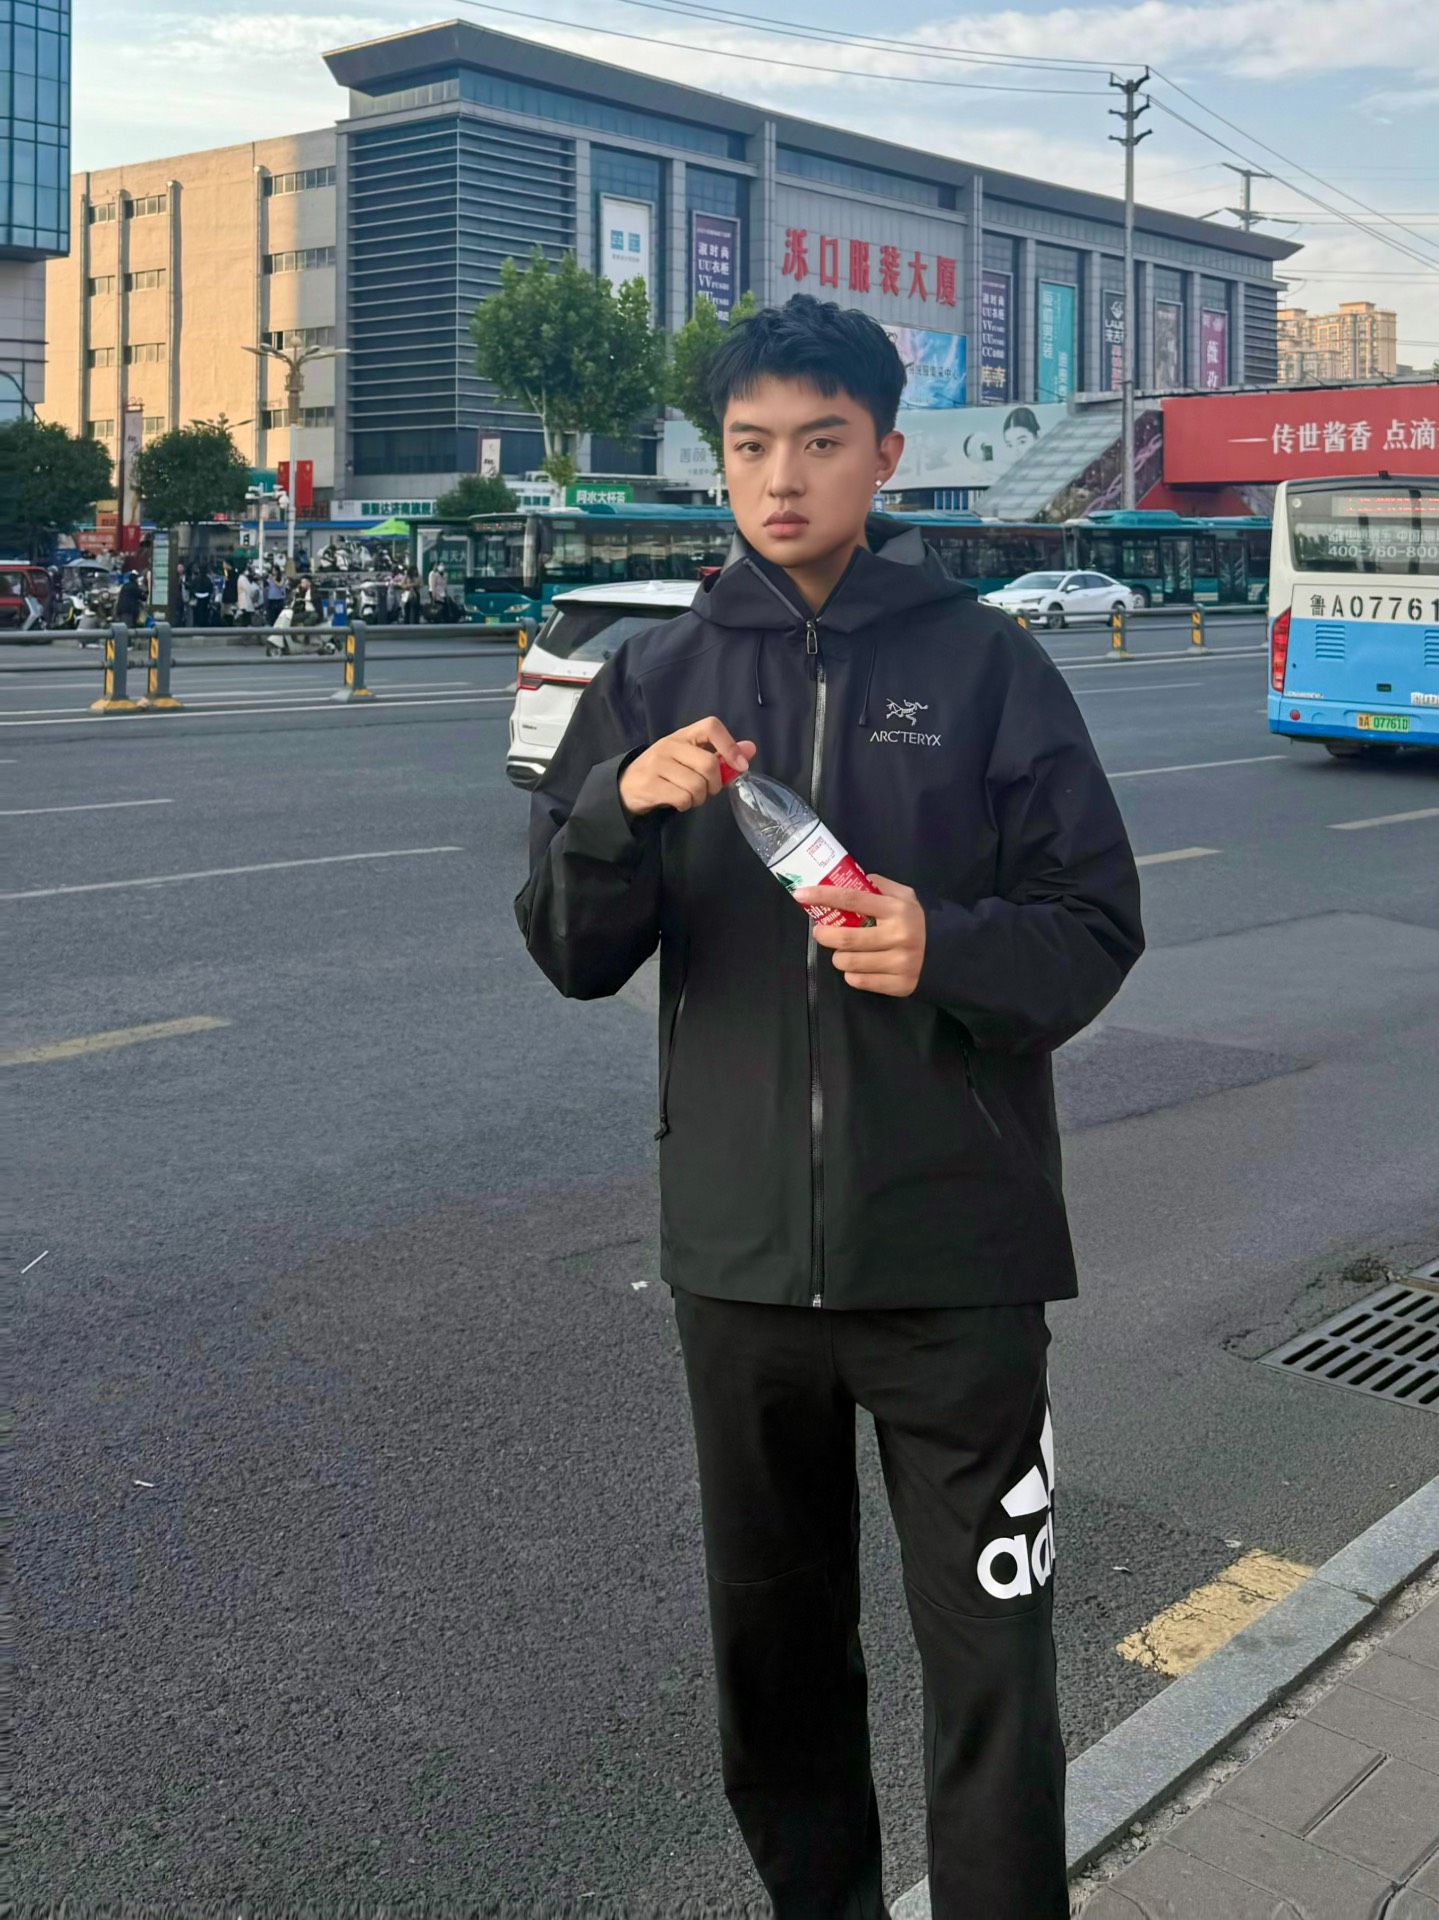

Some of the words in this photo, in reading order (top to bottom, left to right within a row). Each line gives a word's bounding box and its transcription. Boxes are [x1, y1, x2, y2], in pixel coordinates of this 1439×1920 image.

[782, 228, 957, 307] 泺口服装大厦
[1382, 416, 1439, 451] 点滴
[576, 490, 626, 504] 阿水大杯茶
[1328, 545, 1439, 558] 400-760-800
